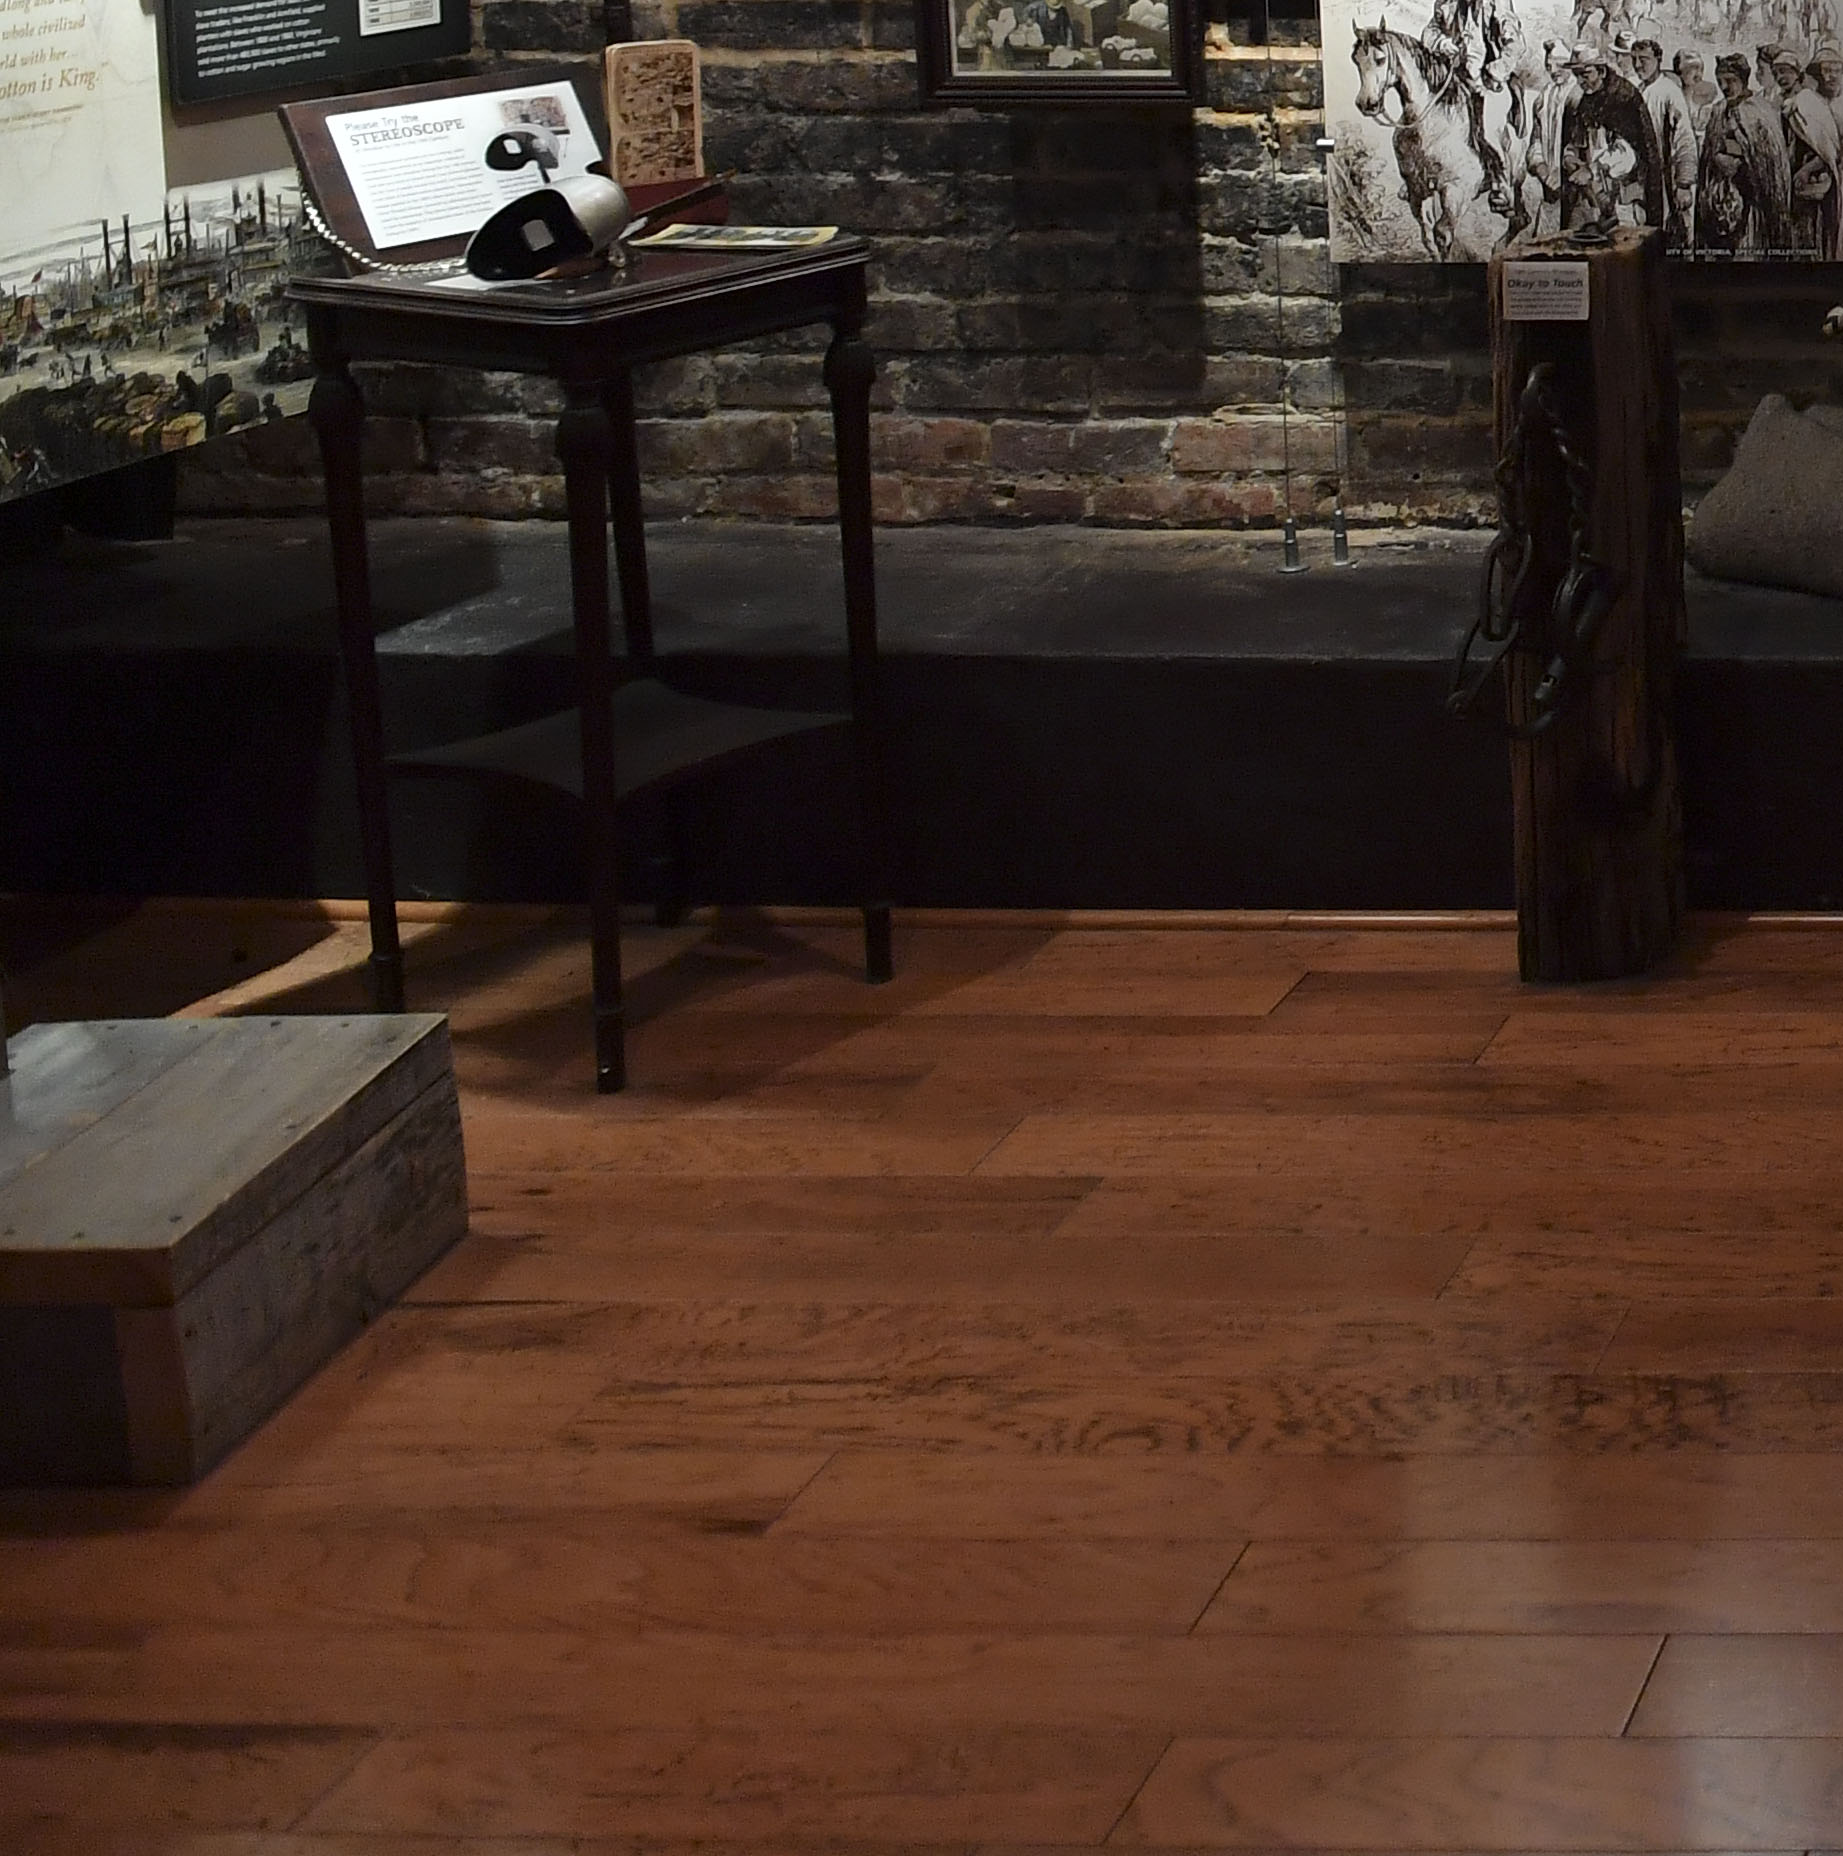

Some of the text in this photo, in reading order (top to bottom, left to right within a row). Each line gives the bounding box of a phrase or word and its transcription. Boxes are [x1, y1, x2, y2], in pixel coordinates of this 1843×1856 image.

[350, 118, 465, 146] STEREOSCOPE
[1506, 278, 1583, 291] Okay to Touch
